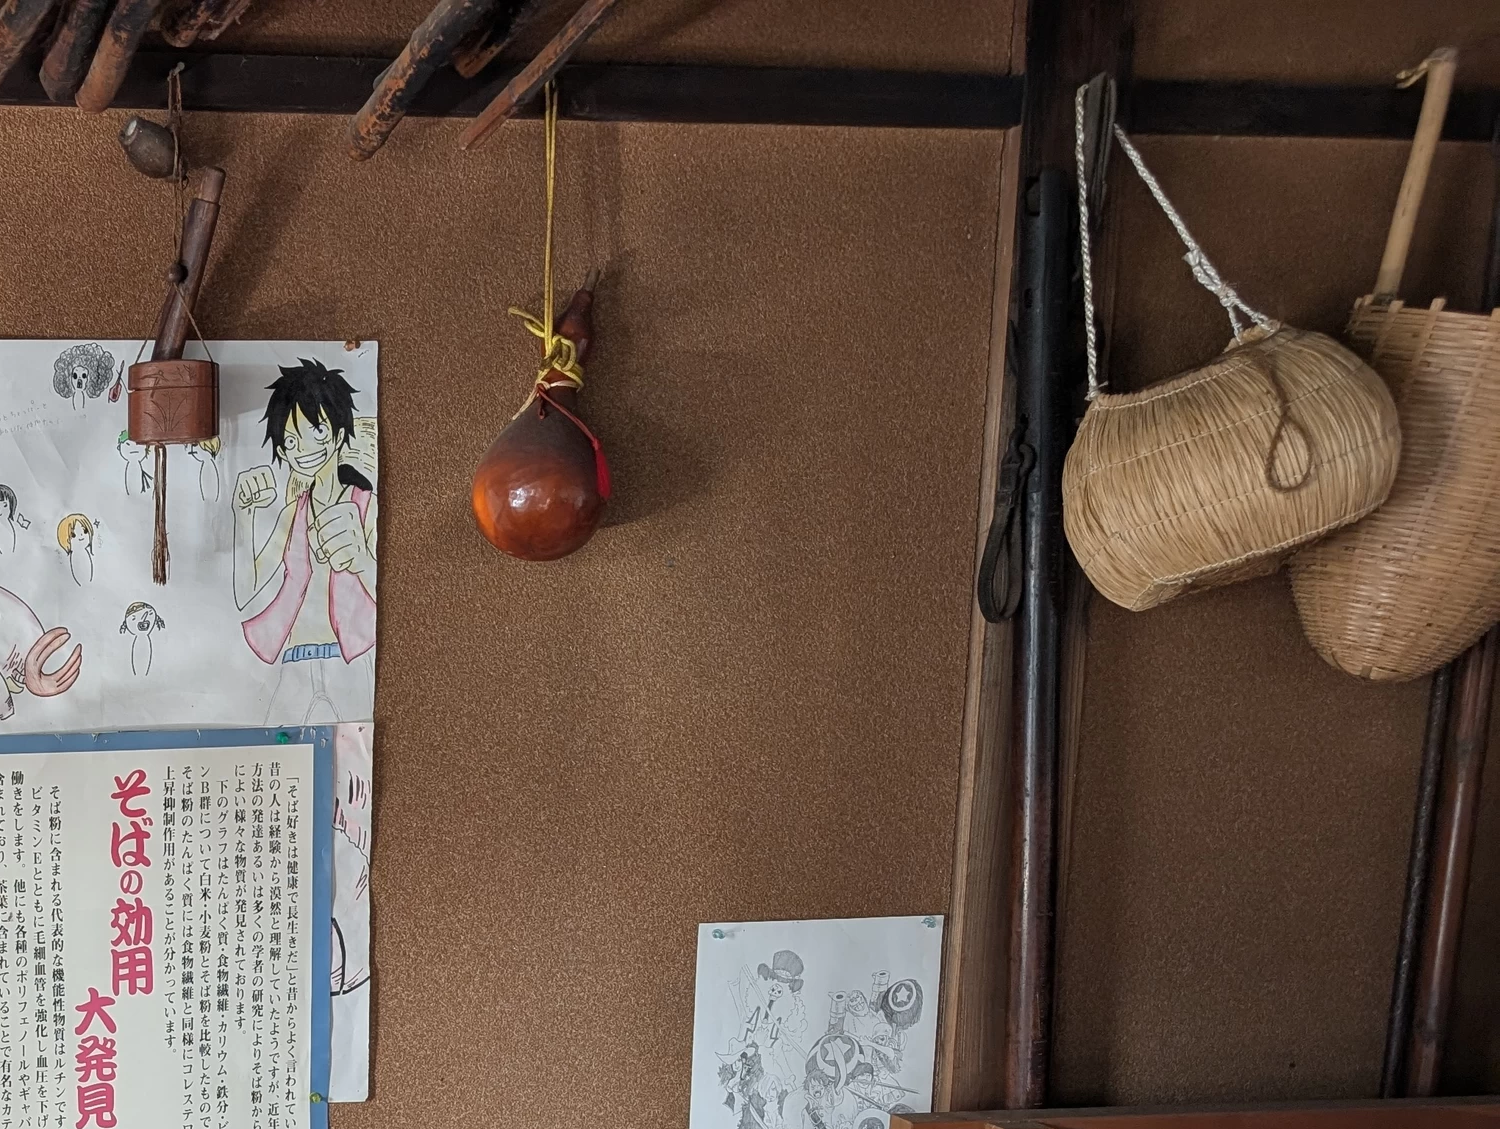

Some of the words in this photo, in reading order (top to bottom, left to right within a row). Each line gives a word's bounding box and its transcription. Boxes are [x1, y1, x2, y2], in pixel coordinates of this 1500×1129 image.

[109, 768, 154, 997] そばの効用
[162, 766, 177, 1053] 上昇抑制作用があることが分かっています。
[234, 764, 247, 1035] によい様々な物質が発見されております。
